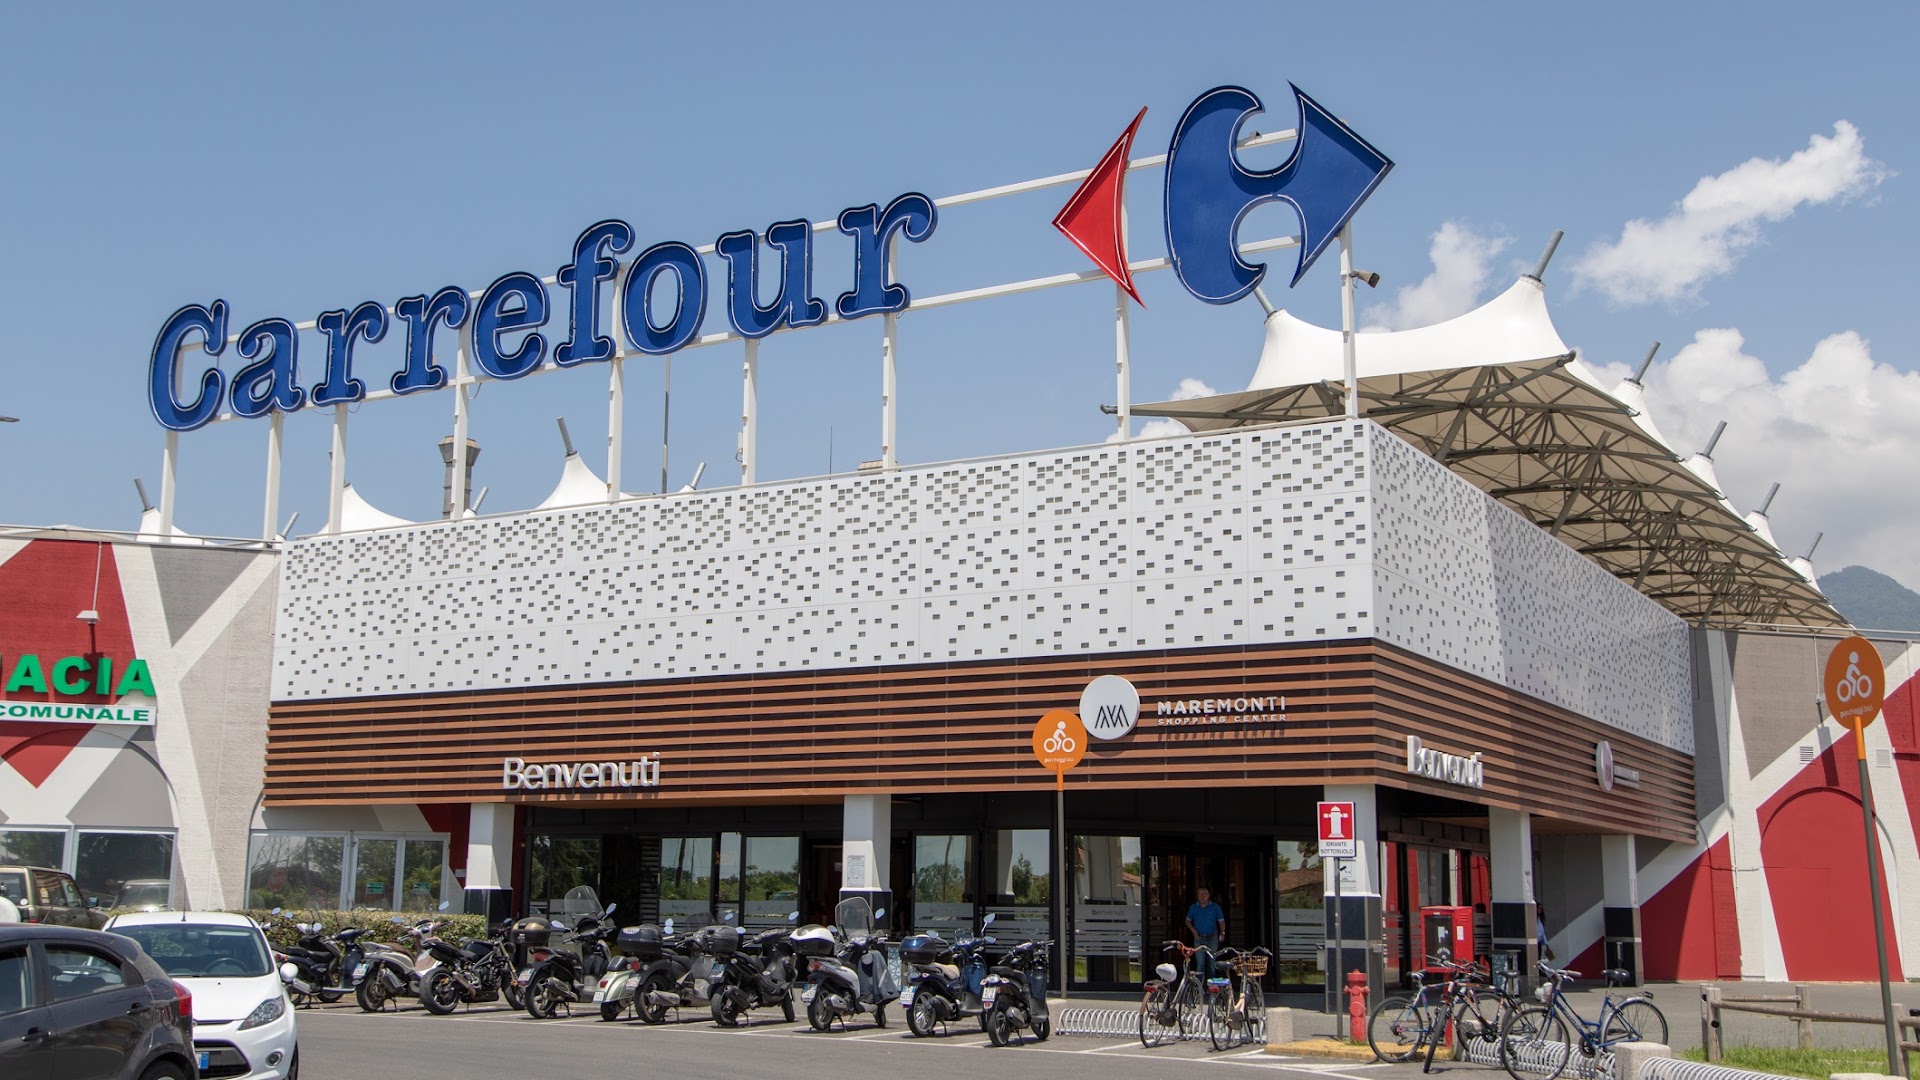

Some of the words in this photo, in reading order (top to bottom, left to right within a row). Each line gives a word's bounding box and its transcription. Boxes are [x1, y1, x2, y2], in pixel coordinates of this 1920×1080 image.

[148, 191, 939, 432] Carrefour
[0, 653, 157, 697] ACIA
[1157, 696, 1286, 716] MAREMONTI
[1157, 716, 1226, 726] SHOPPING
[1234, 714, 1286, 723] CENTER
[503, 751, 661, 790] Benvenuti
[1406, 735, 1484, 789] Benvenuti
